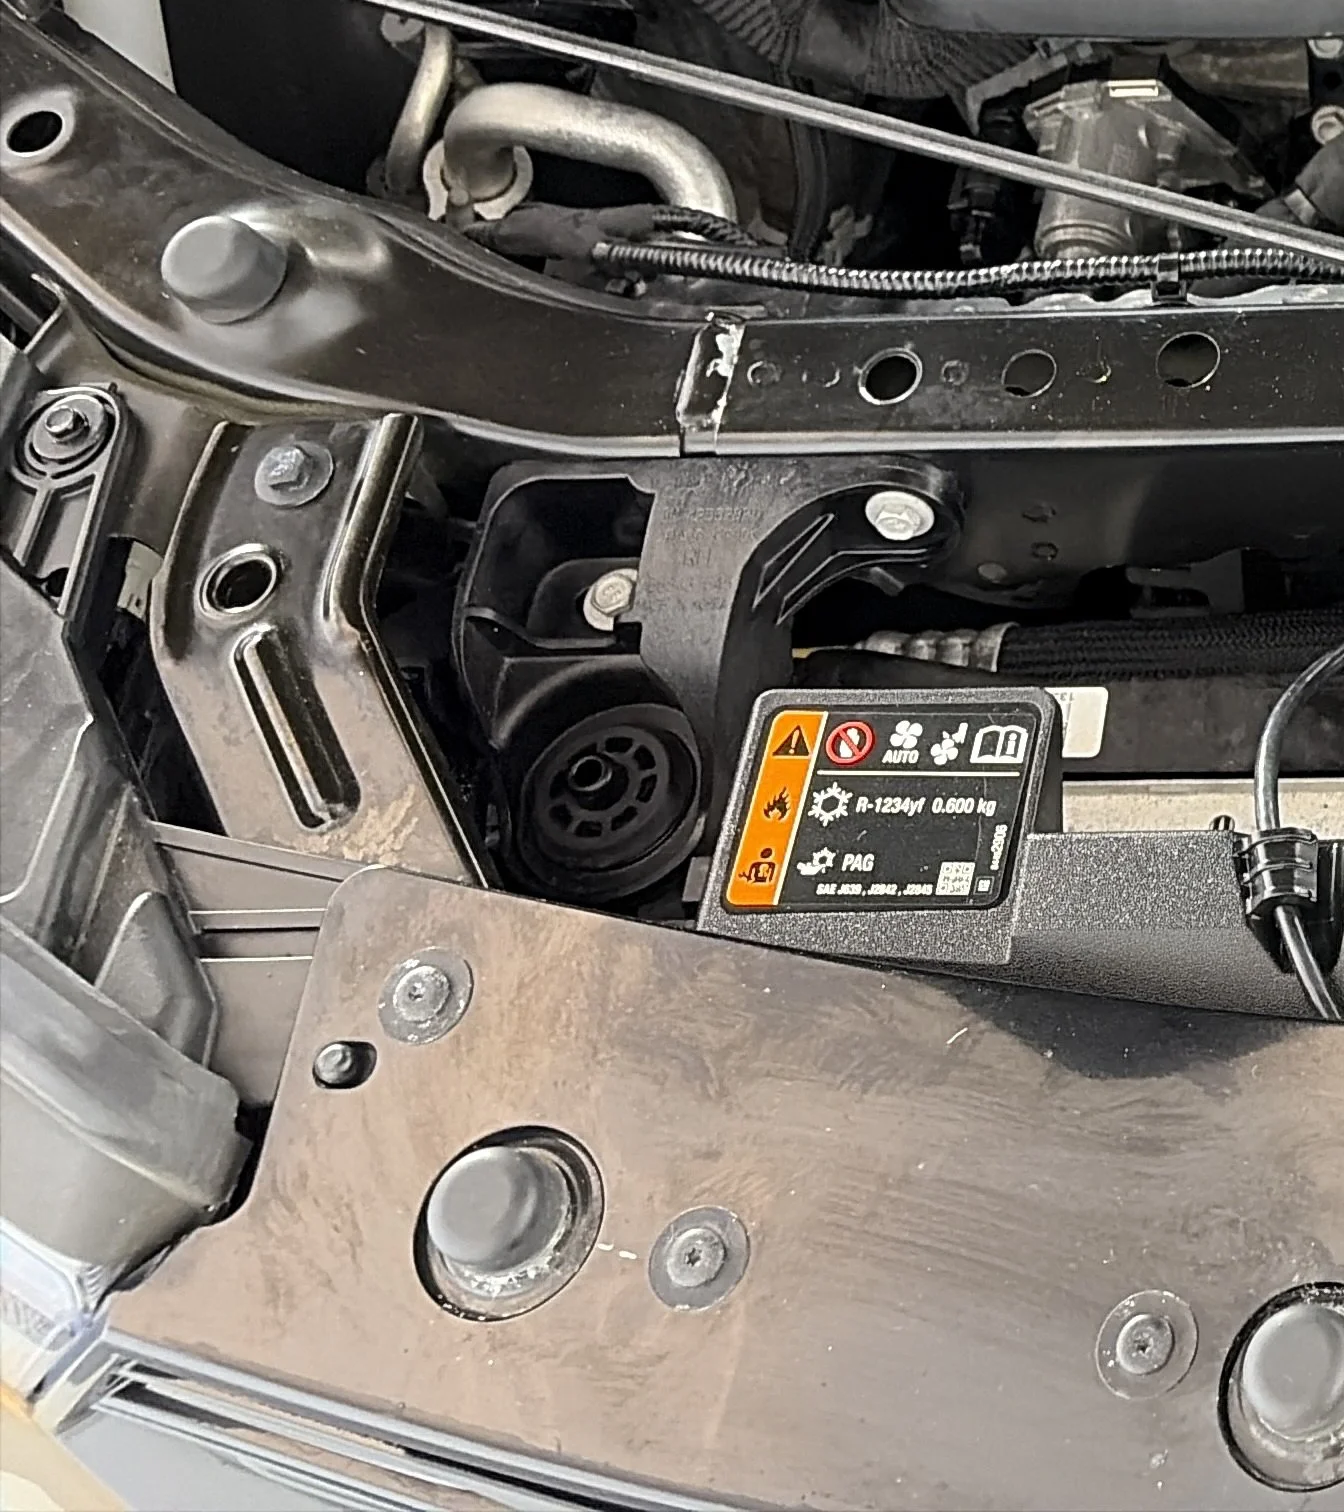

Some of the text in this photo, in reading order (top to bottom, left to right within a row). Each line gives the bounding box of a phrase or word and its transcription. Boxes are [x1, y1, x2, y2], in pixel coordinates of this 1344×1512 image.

[881, 749, 920, 764] AUTO
[855, 796, 997, 817] R-1234yf 0.600 kg
[841, 853, 875, 872] PAG
[815, 883, 838, 896] SAE
